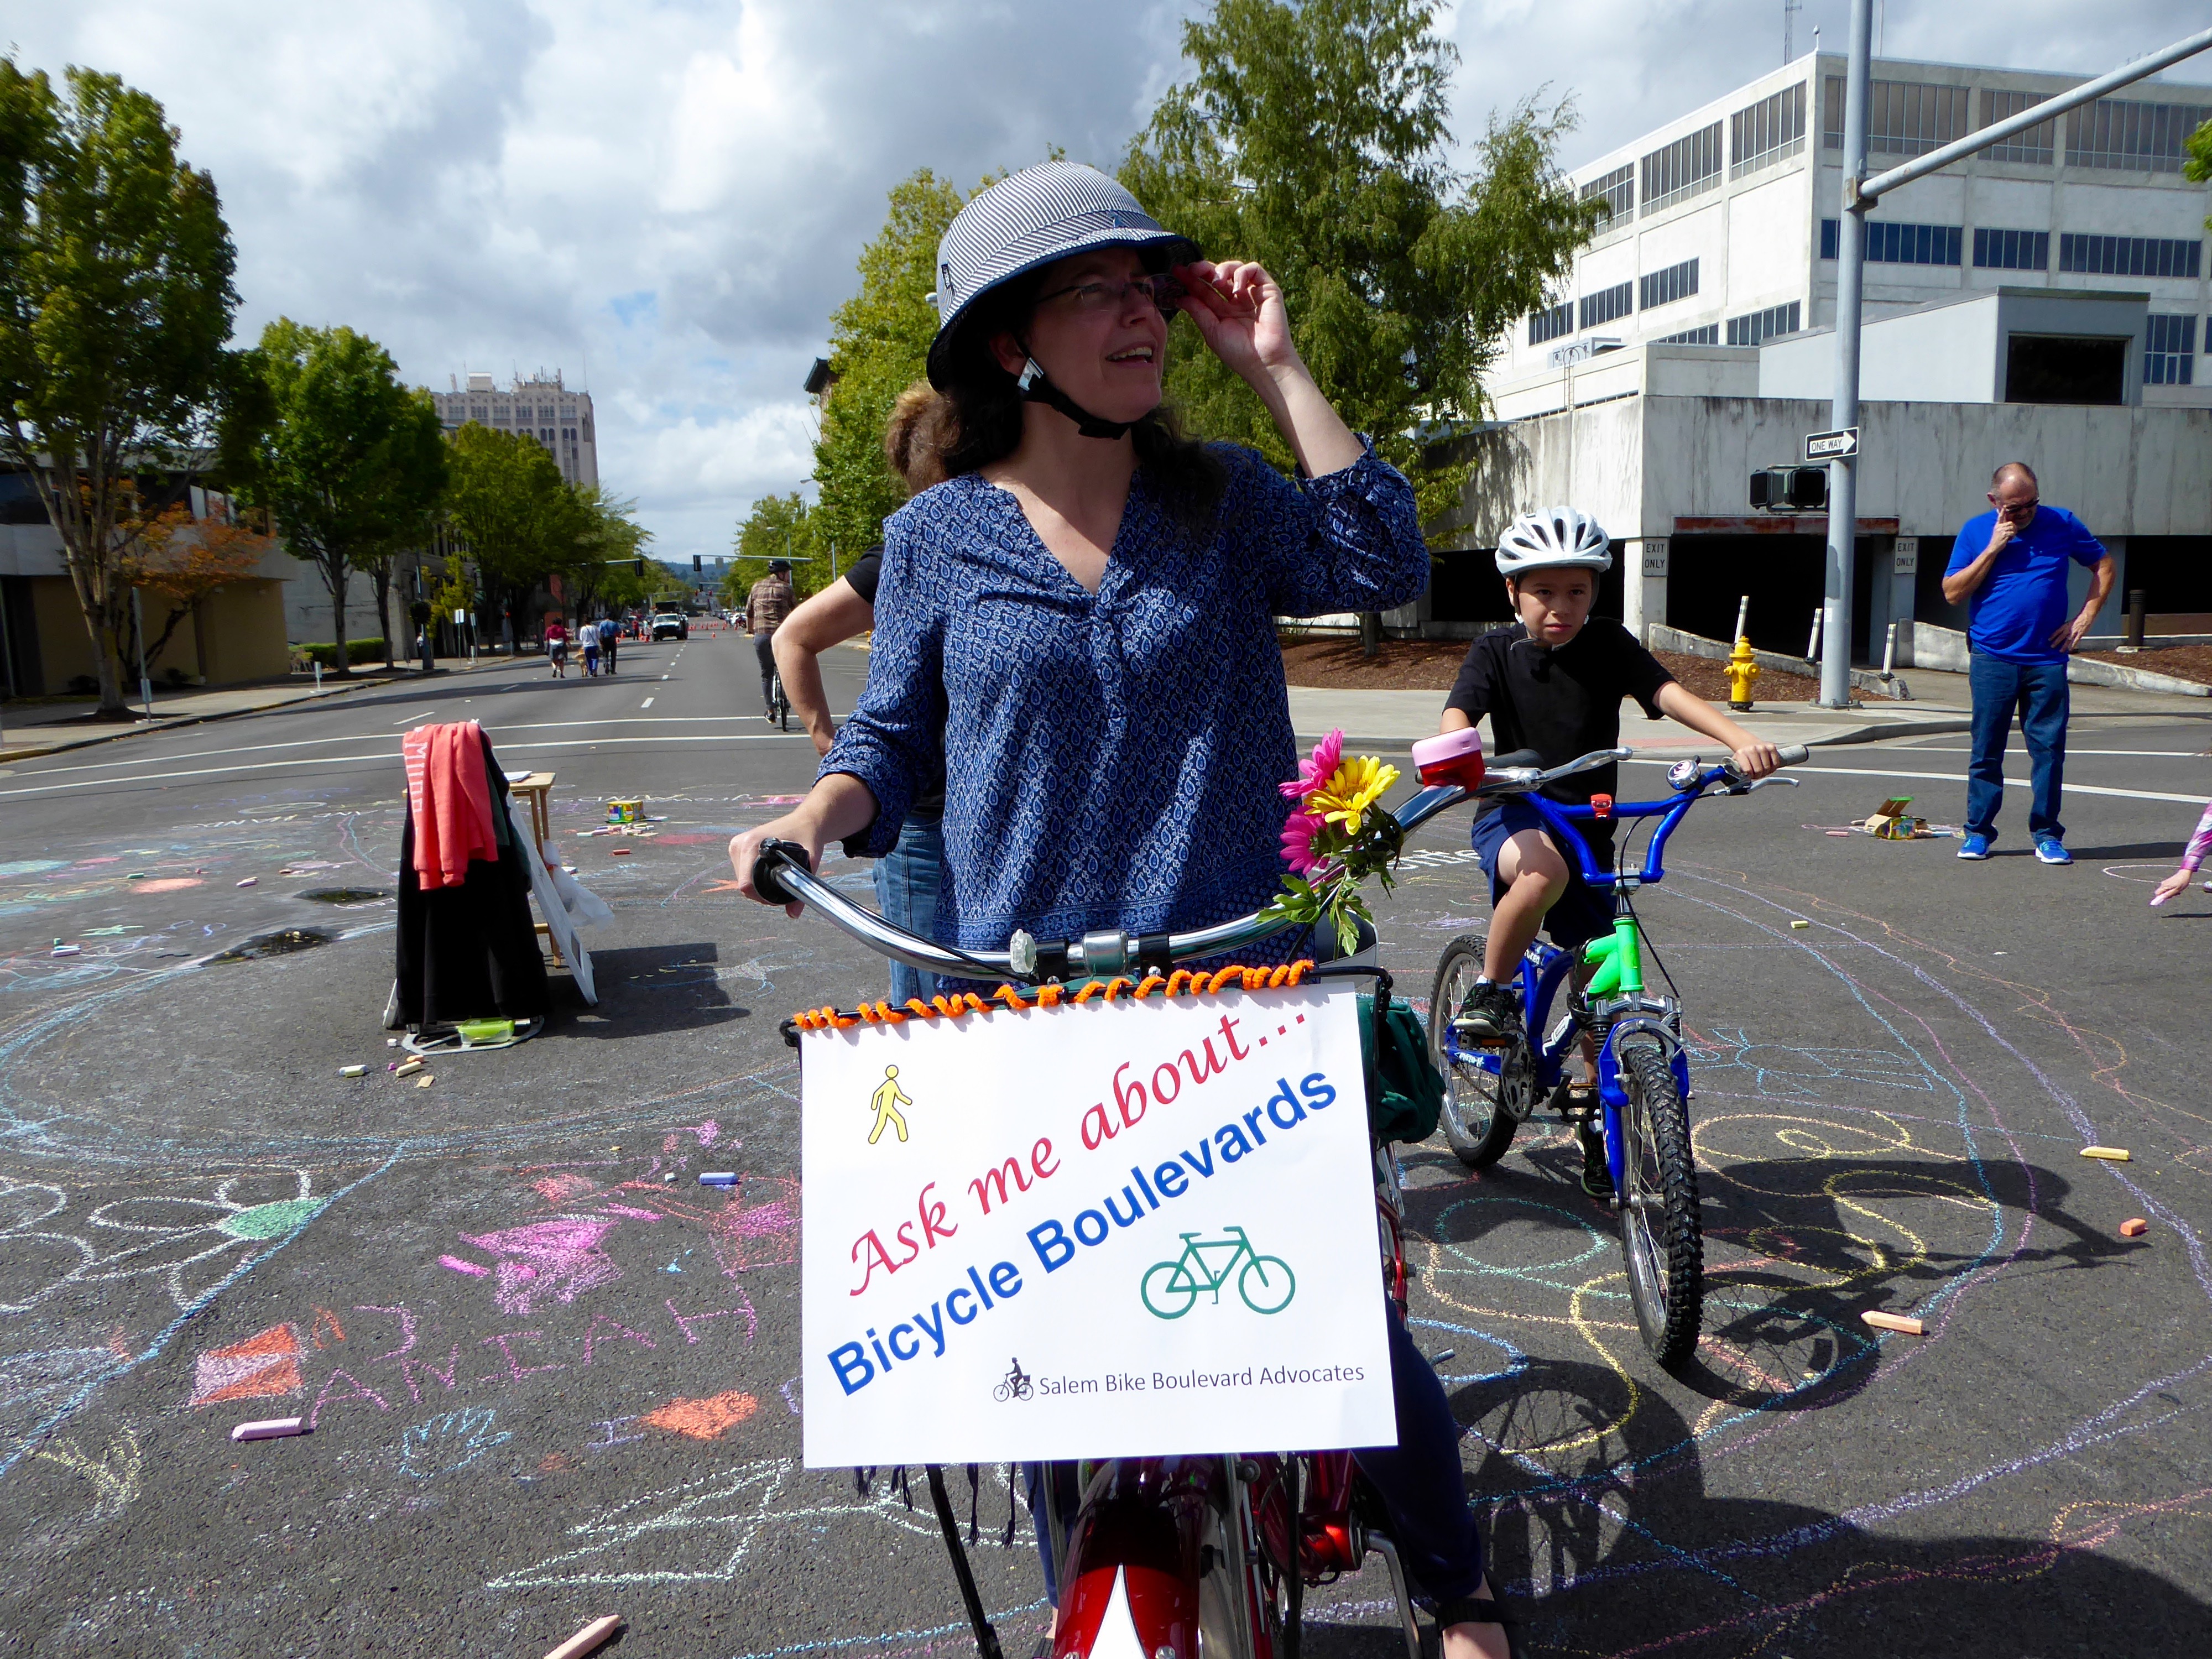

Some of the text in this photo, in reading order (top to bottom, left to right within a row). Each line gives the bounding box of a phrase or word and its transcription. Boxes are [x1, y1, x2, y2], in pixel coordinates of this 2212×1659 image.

[1811, 439, 1843, 452] ONE WAY
[1646, 544, 1665, 553] EXIT
[1897, 542, 1914, 552] EXIT
[1645, 559, 1665, 568] ONLY
[1896, 557, 1914, 567] ONLY
[849, 1183, 957, 1297] Ask
[968, 1138, 1060, 1215] me
[828, 1073, 1336, 1396] Bicycle Boulevards
[1040, 1365, 1365, 1395] Salem Bike Boulevard Advocates
